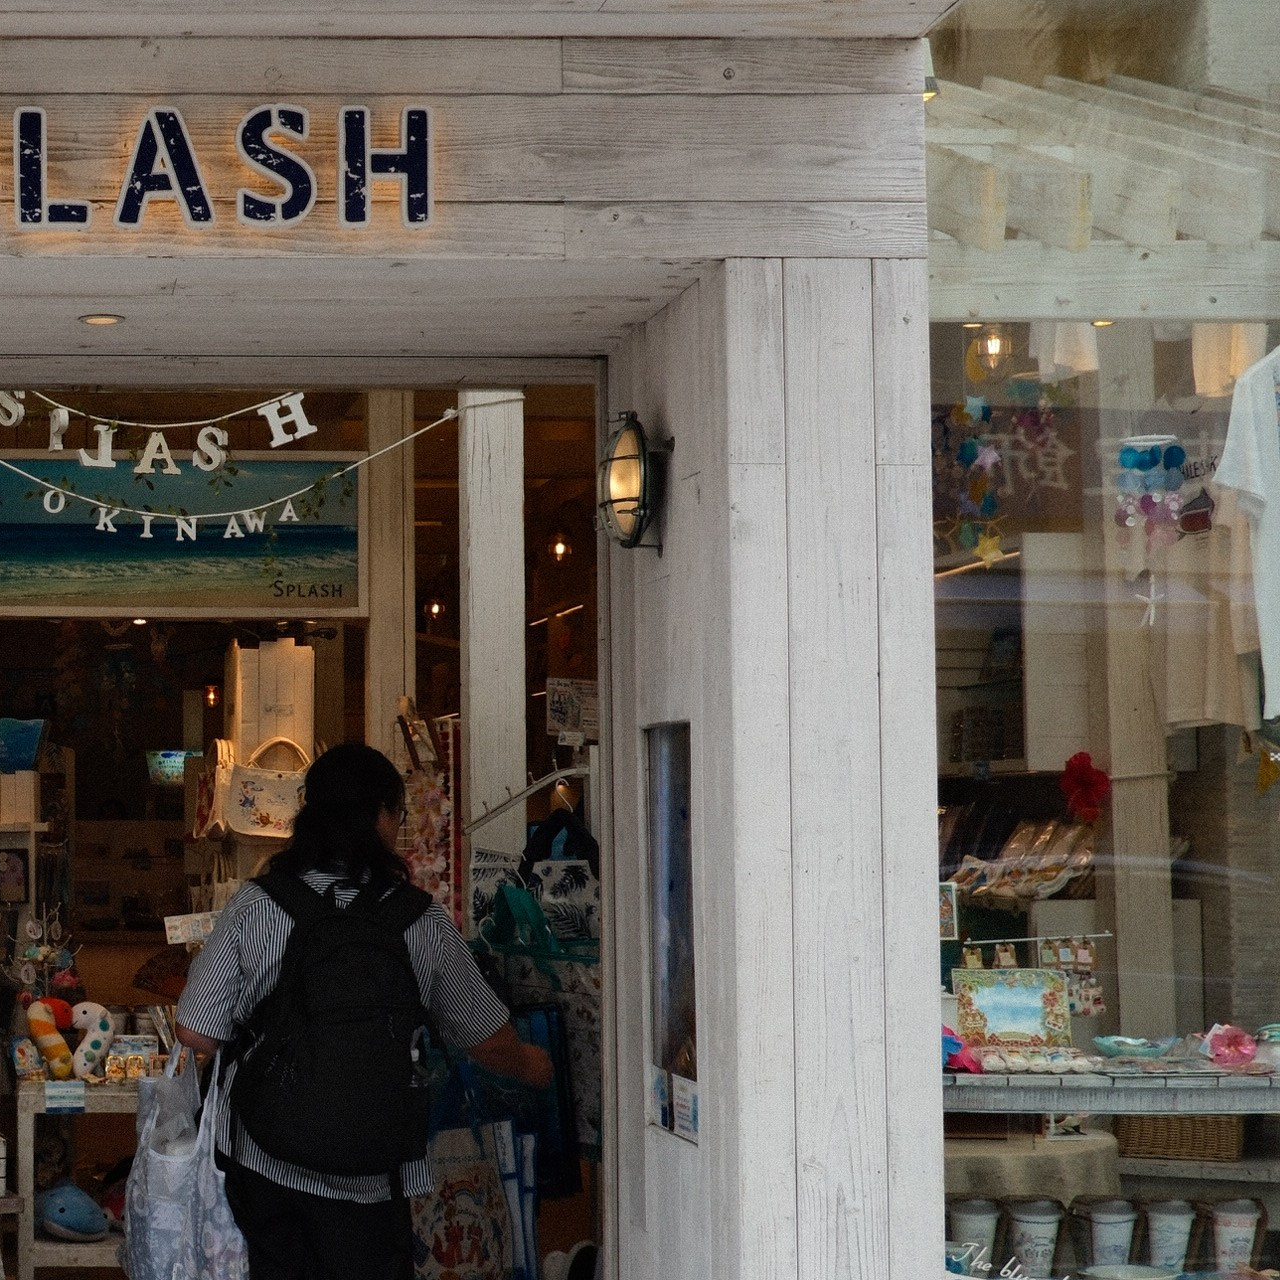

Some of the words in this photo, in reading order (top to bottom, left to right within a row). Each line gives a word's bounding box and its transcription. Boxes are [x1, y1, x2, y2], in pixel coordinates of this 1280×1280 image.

[43, 490, 300, 541] OKINAWA
[273, 579, 343, 598] SPLASH
[951, 1242, 992, 1272] The
